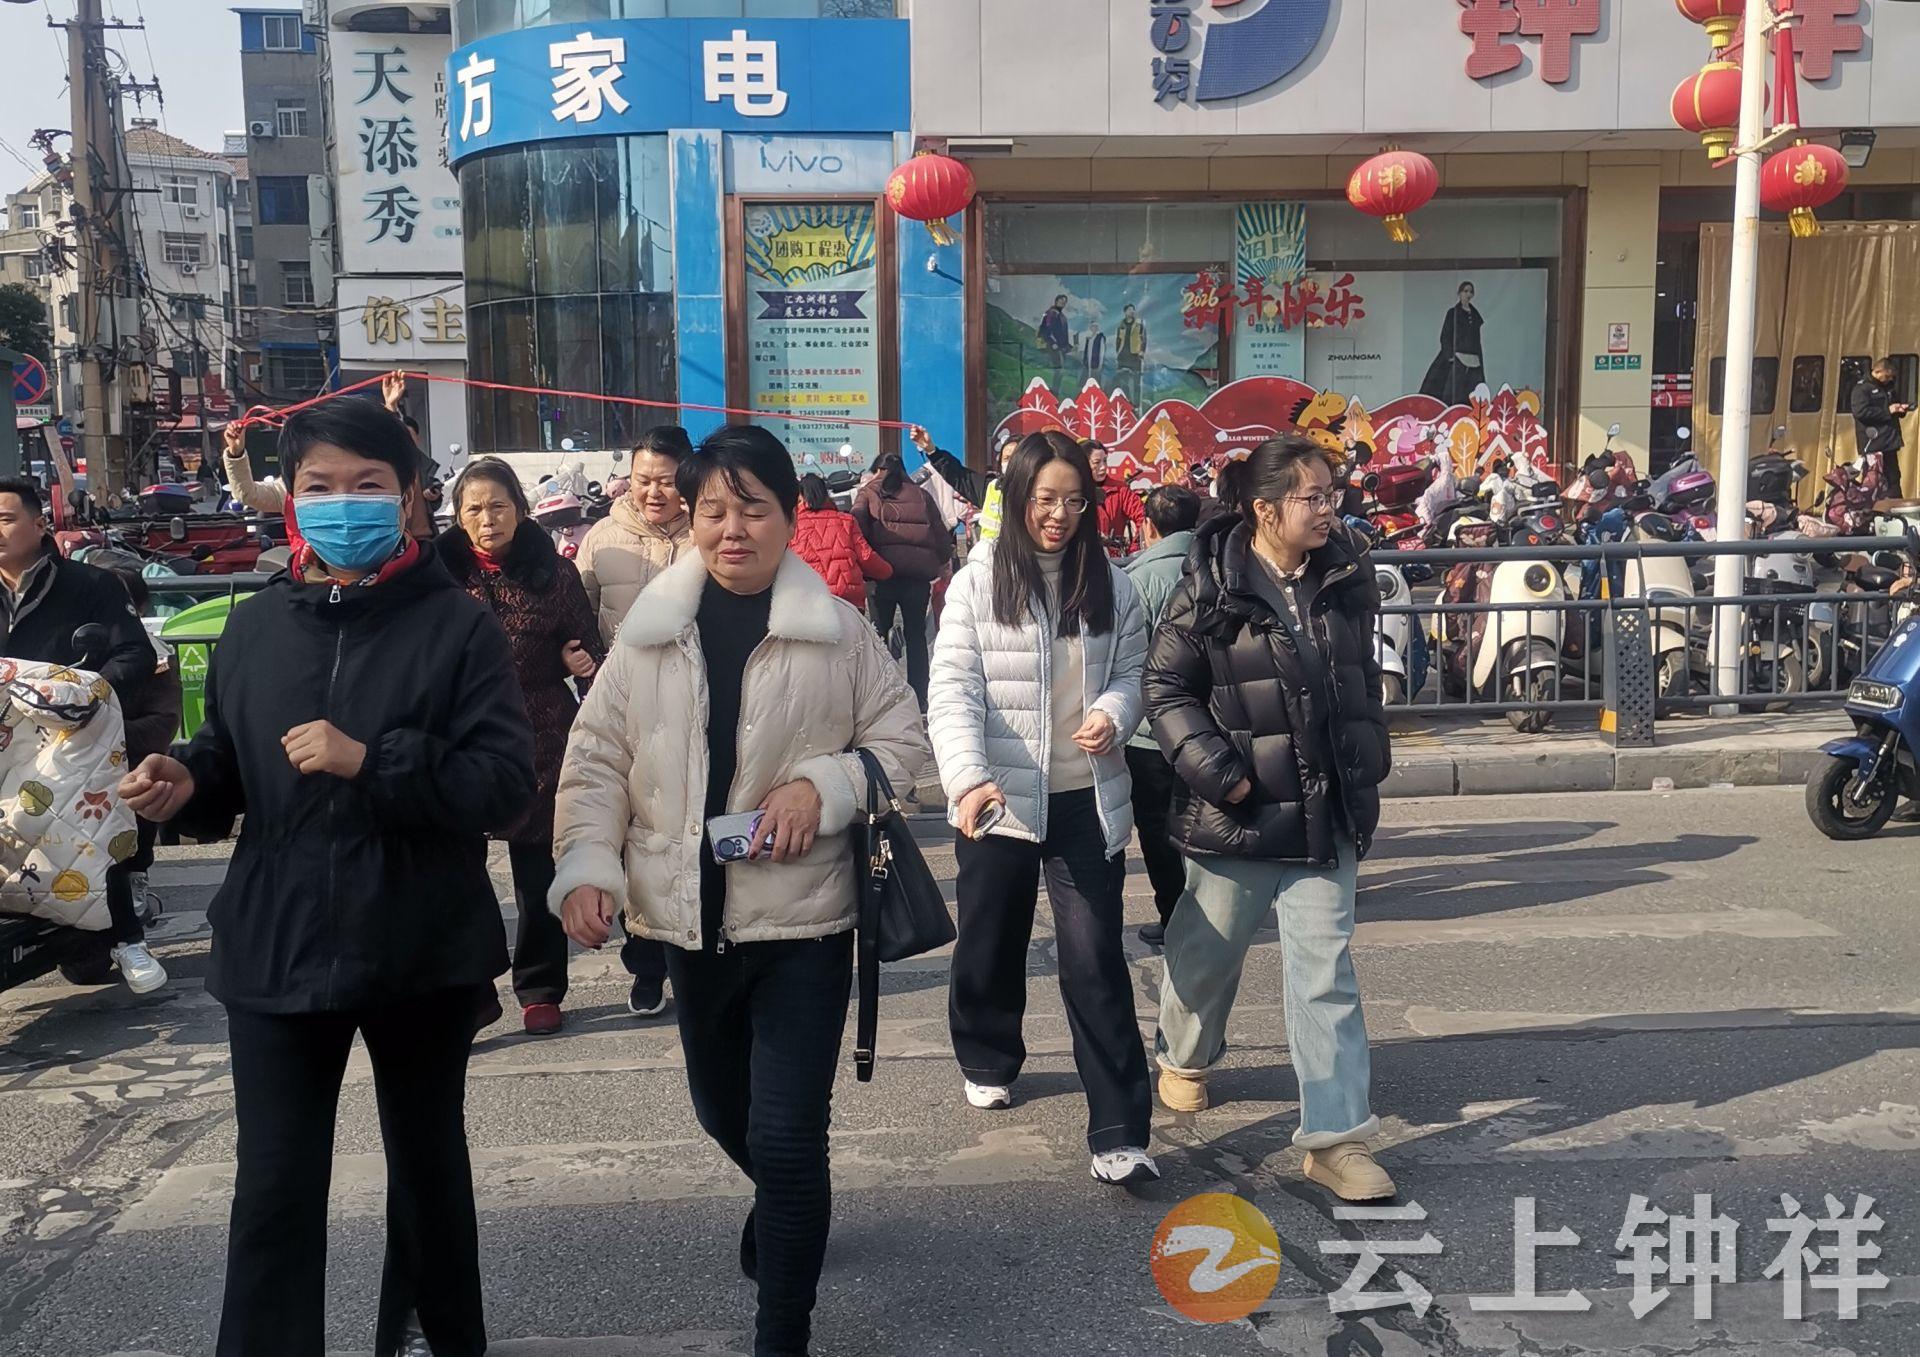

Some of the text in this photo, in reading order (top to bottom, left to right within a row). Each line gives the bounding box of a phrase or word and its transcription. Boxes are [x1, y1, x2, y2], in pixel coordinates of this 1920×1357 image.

[1150, 0, 1191, 102] 百货
[457, 29, 788, 142] 方家电
[354, 46, 421, 245] 天添秀
[760, 146, 843, 174] vivo
[775, 240, 846, 257] 团购工程惠
[361, 295, 466, 344] 你主
[1181, 287, 1220, 313] 2026
[1183, 270, 1366, 336] 新年快乐
